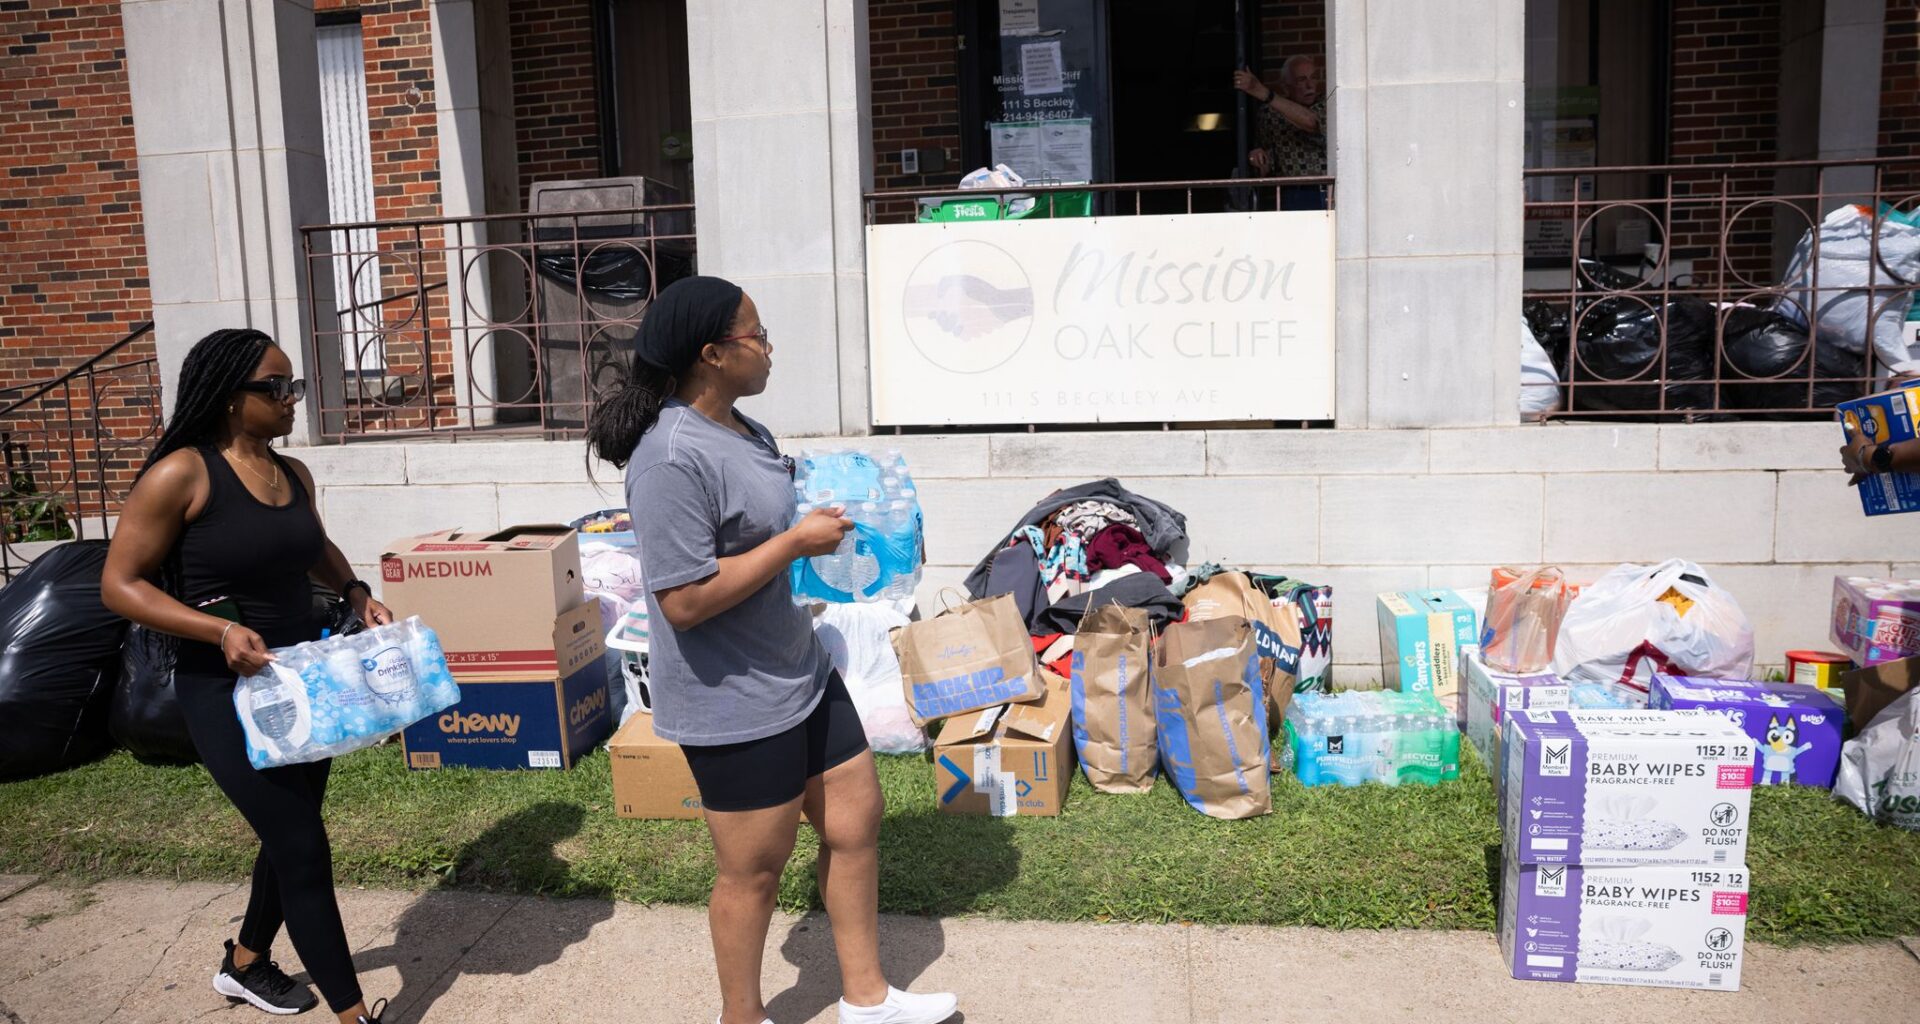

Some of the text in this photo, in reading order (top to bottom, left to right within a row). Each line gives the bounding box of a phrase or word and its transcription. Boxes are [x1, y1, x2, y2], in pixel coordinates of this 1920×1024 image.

[993, 74, 1024, 86] Missio
[1001, 97, 1075, 109] 111 S Beckley
[1002, 109, 1075, 122] 214-942-6407
[952, 204, 986, 218] Fiesta
[1532, 207, 1591, 218] PERMITDO
[1053, 241, 1297, 314] Mission
[1054, 320, 1297, 361] OAK CLIFF
[982, 388, 1219, 408] 111 S BECKLEY AVE
[407, 560, 493, 578] MEDIUM
[1411, 641, 1430, 692] Pampers
[1433, 643, 1444, 686] swaddlers
[570, 686, 606, 726] chewy
[438, 710, 521, 737] chewy
[501, 737, 517, 745] shop
[1591, 753, 1638, 761] PREMIUM
[1696, 745, 1748, 757] 1152 12
[1591, 763, 1706, 777] BABY WIPES
[1590, 777, 1675, 785] FRAGRANCE-FREE
[1721, 772, 1737, 781] $10
[1025, 800, 1045, 808] club
[1702, 828, 1742, 837] DO NOT
[1705, 837, 1738, 846] FLUSH
[1586, 876, 1633, 884] PREMIUM
[1691, 872, 1743, 884] 1152 12
[1586, 885, 1701, 902] BABY WIPES
[1585, 899, 1670, 909] FRAGRANCE-FREE
[1698, 952, 1737, 961] DO NOT
[1700, 961, 1733, 969] FLUSH
